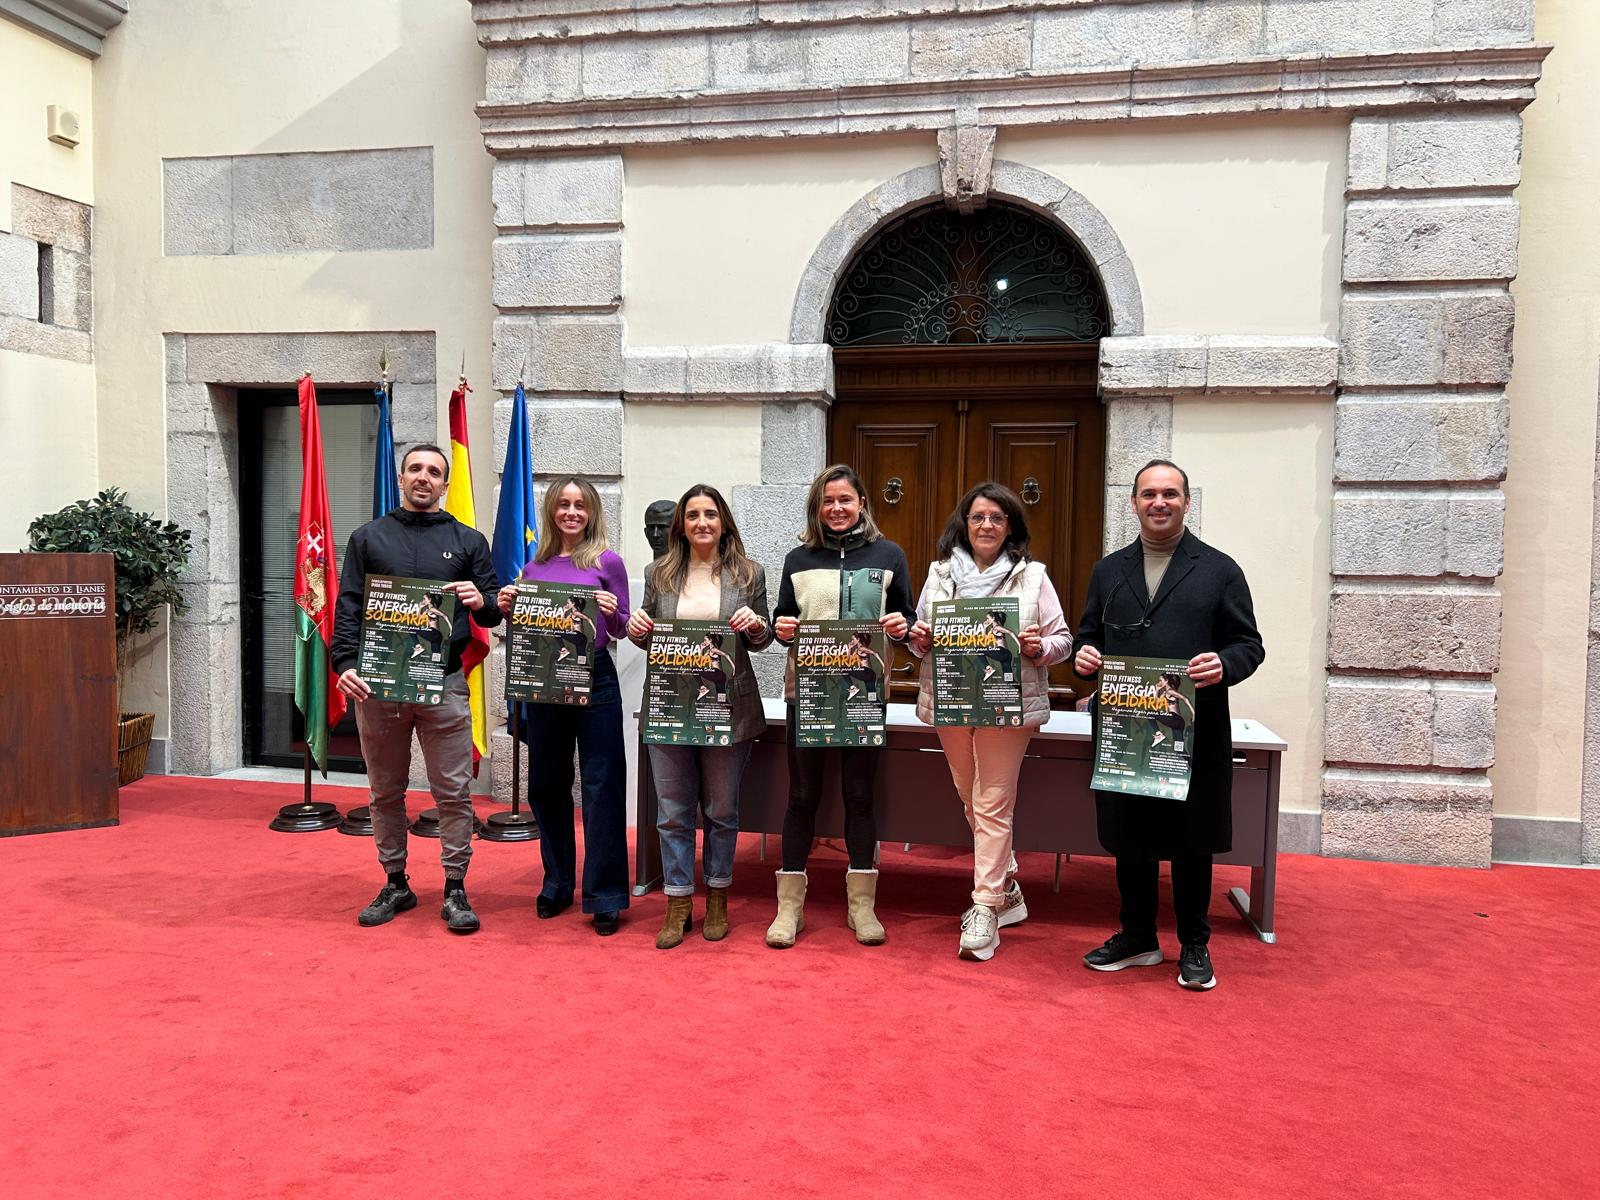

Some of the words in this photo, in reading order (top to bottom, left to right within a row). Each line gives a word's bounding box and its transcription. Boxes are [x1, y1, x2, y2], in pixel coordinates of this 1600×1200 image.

[76, 585, 106, 594] LLANES
[384, 592, 407, 601] FITNESS
[367, 599, 420, 616] ENERGÍA
[531, 597, 552, 605] FITNESS
[514, 604, 564, 618] ENERGÍA
[365, 610, 430, 628] SOLIDARIA
[512, 614, 573, 631] SOLIDARIA
[934, 621, 984, 636] ENERGÍA
[933, 634, 997, 647] SOLIDARIA
[650, 642, 701, 656] ENERGÍA
[798, 641, 849, 656] ENERGÍA
[649, 653, 712, 668] SOLIDARIA
[796, 654, 861, 667] SOLIDARIA
[1118, 675, 1142, 684] FITNESS
[1102, 681, 1156, 698] ENERGÍA
[1100, 693, 1169, 712] SOLIDARIA
